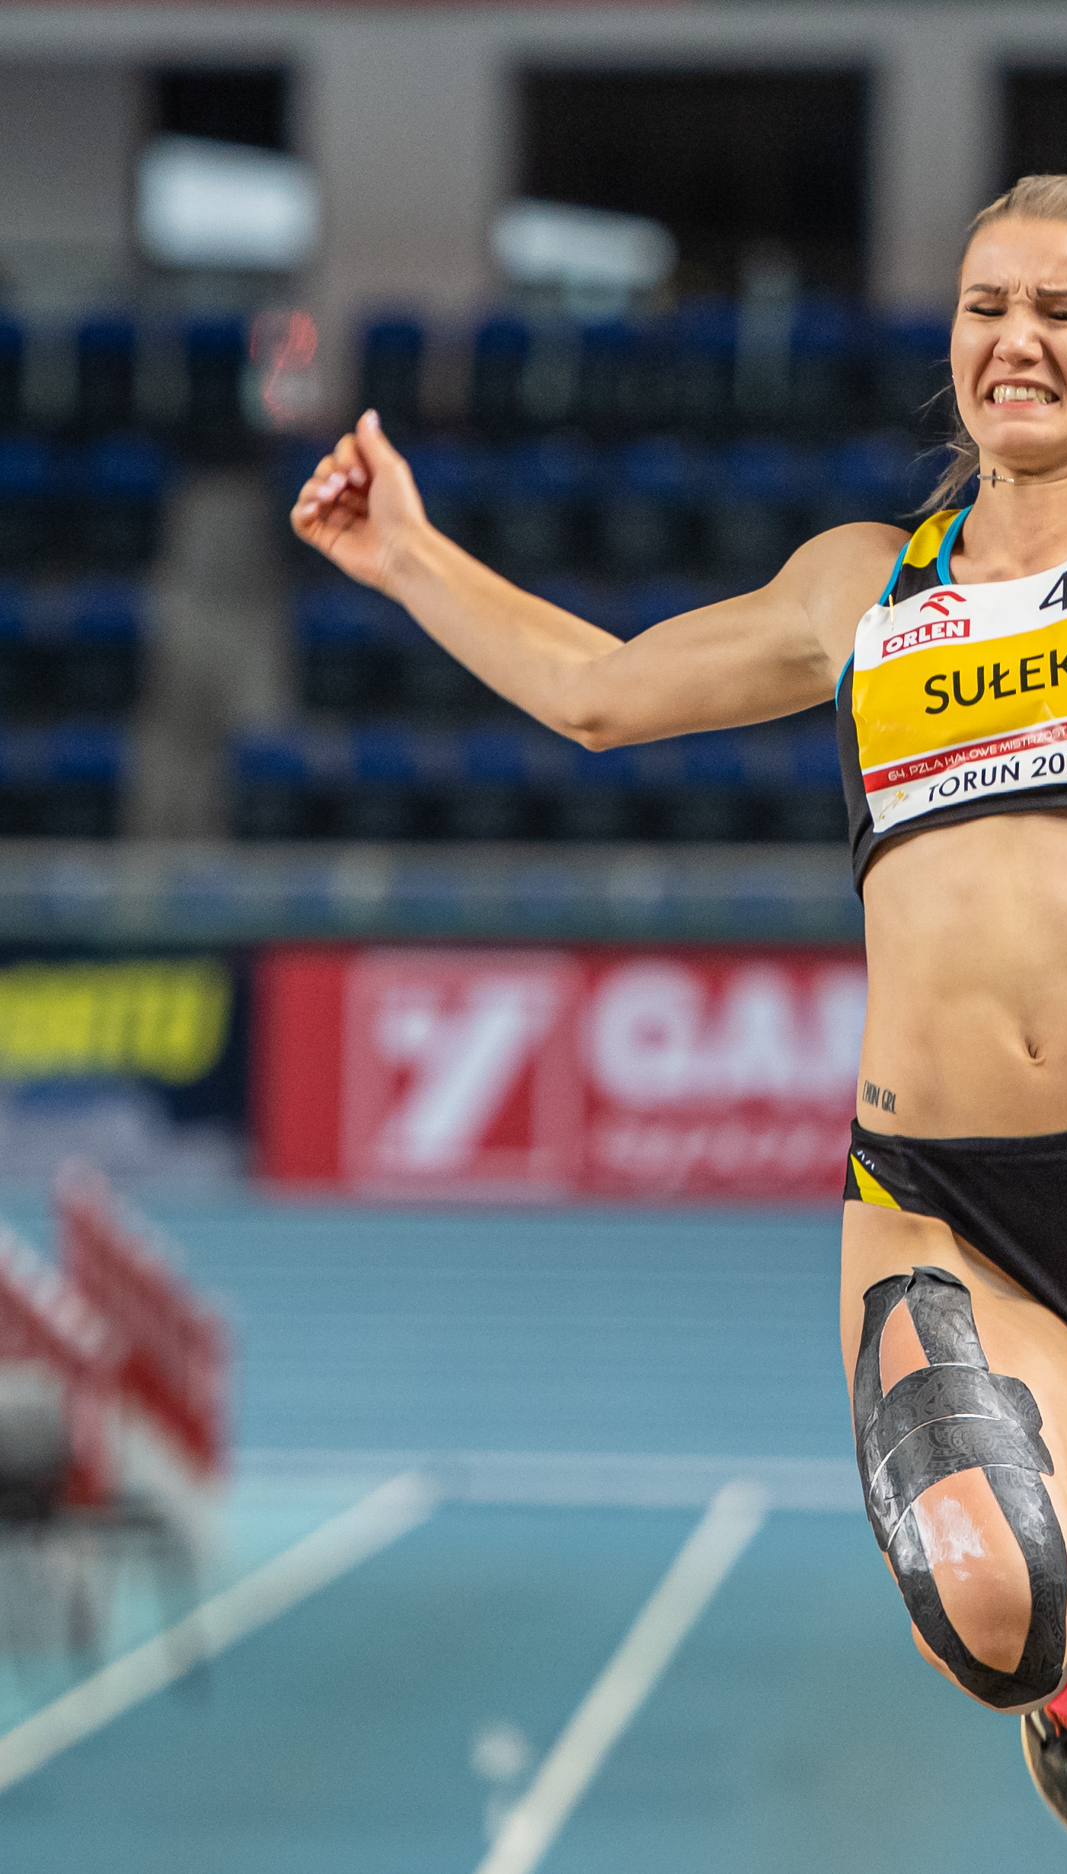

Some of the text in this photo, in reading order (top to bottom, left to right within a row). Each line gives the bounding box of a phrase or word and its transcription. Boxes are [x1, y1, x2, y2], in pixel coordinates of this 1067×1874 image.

[884, 620, 967, 655] ORLEN
[887, 768, 908, 782] 64.
[908, 758, 944, 778] PZLA
[944, 743, 998, 766] HALOWE
[928, 755, 1021, 803] TORUŃ
